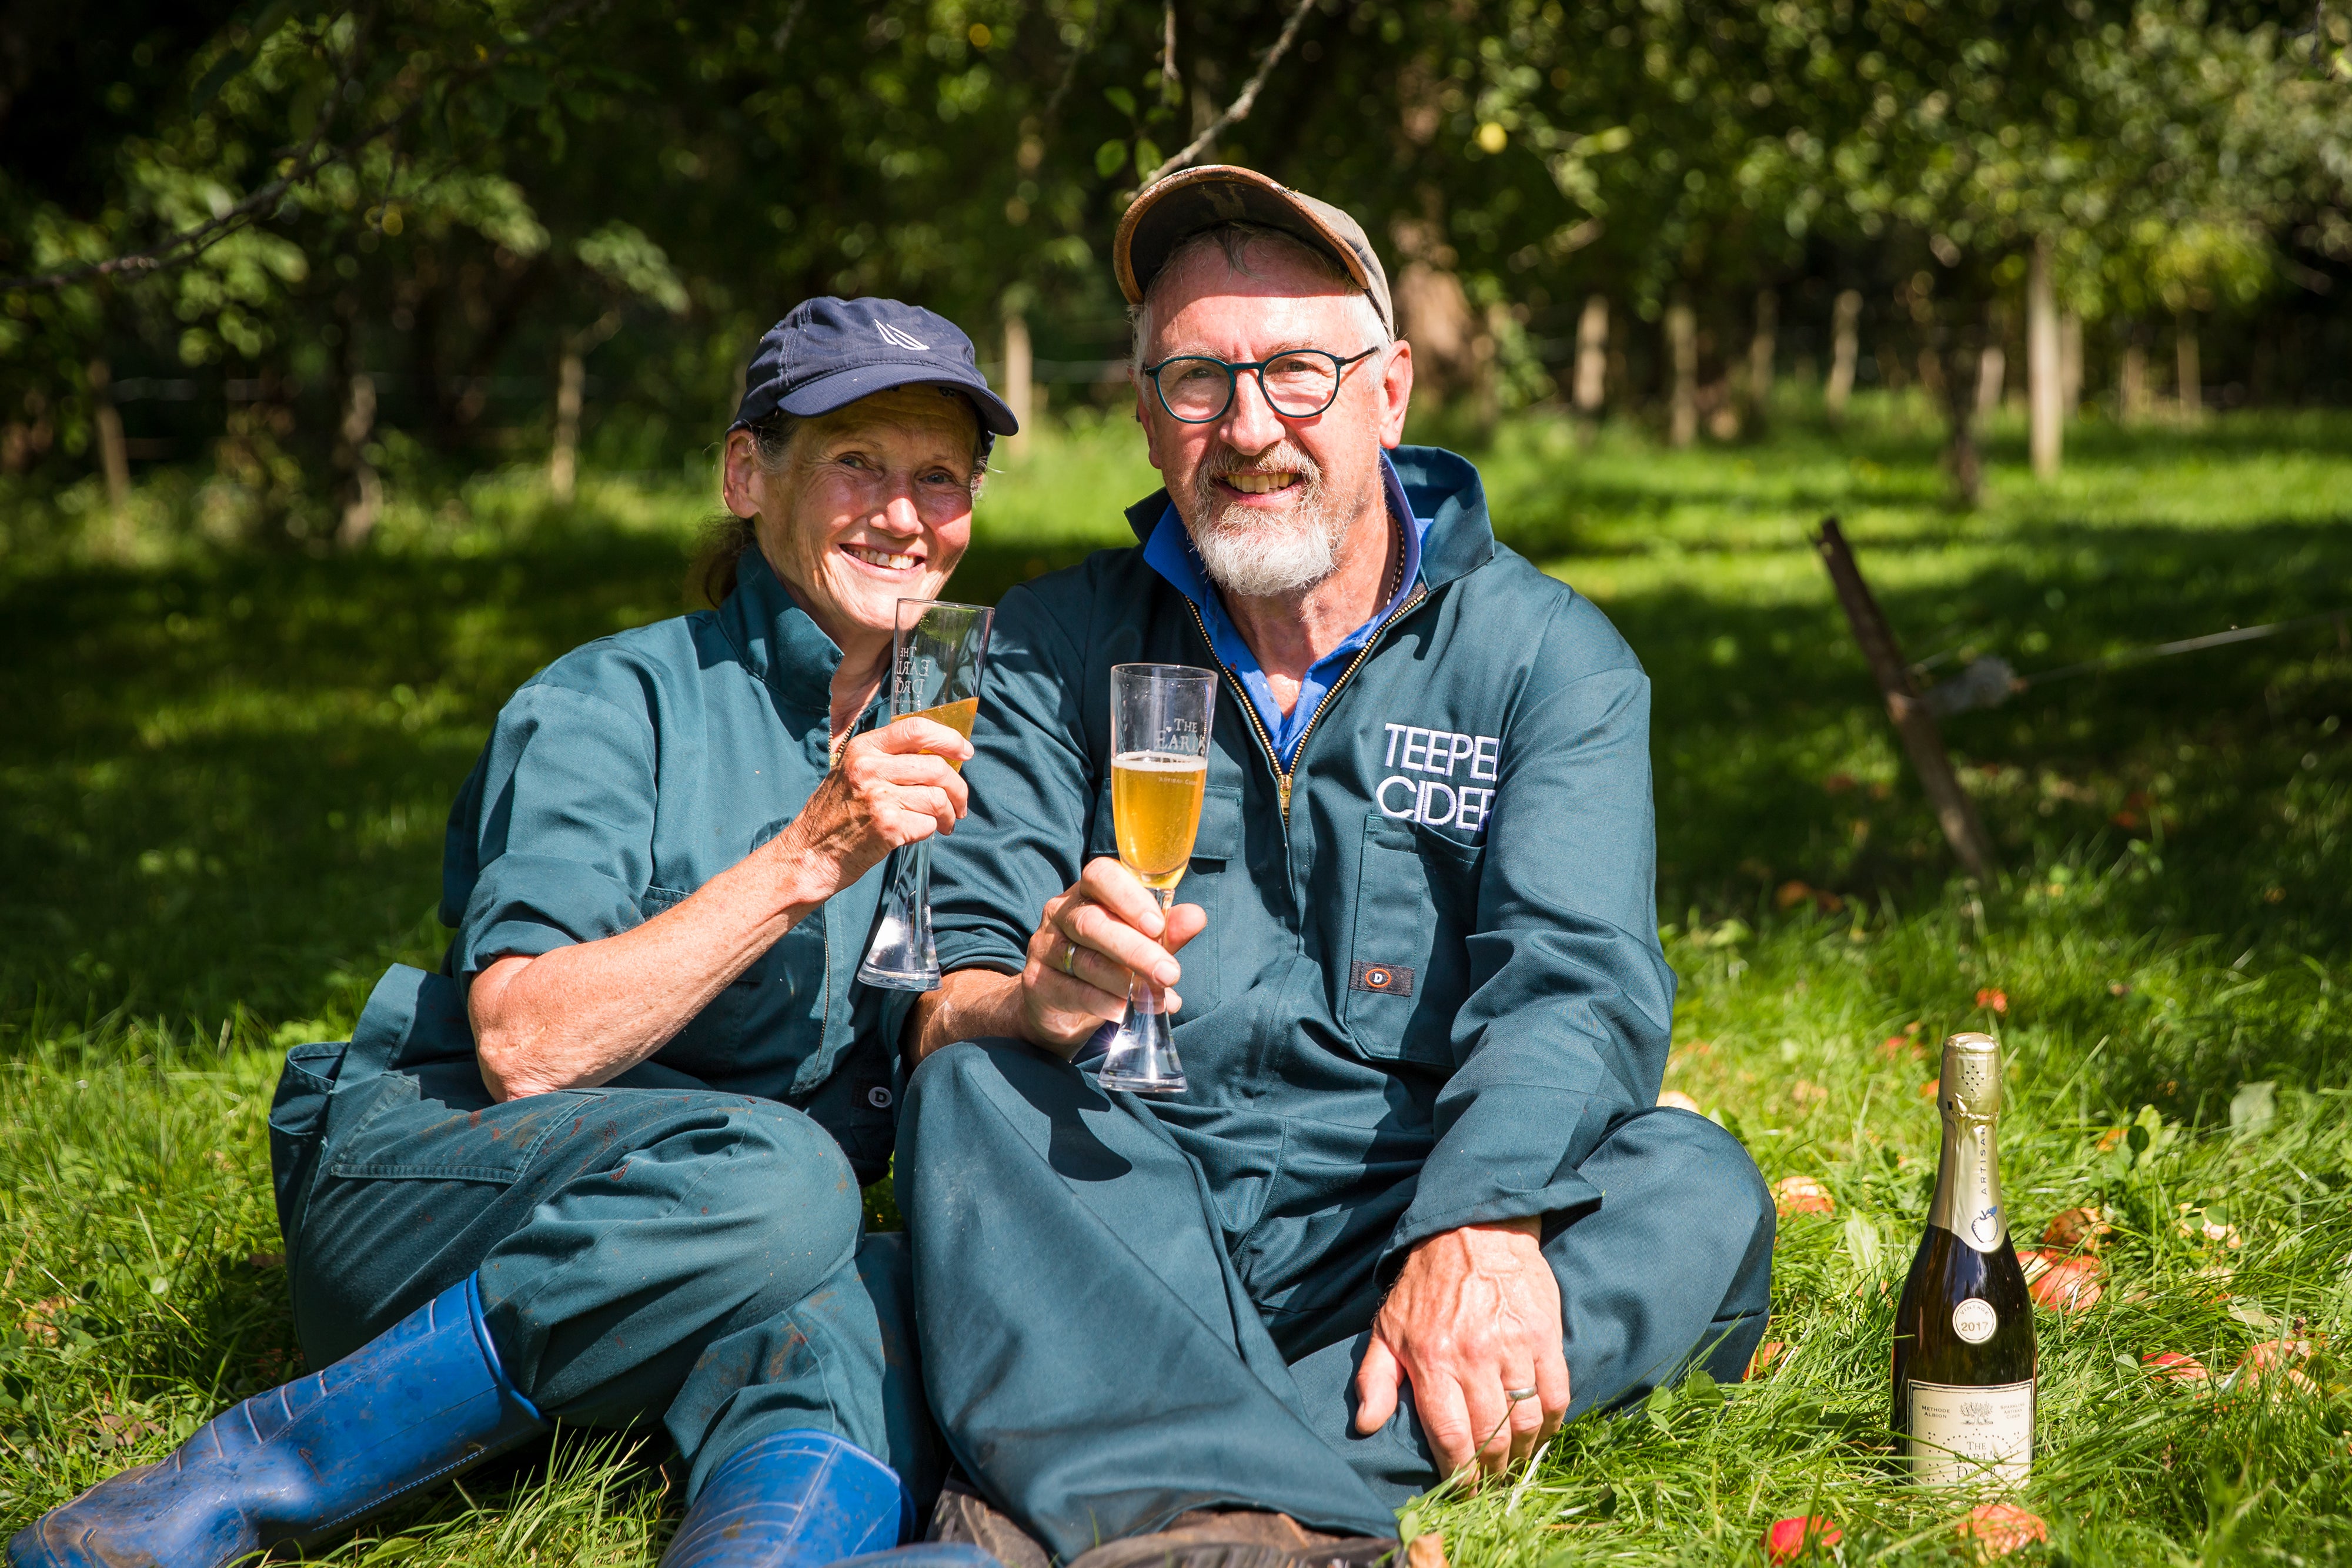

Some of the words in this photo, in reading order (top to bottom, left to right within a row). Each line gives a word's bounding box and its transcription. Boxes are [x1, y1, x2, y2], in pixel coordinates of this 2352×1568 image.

[1174, 718, 1198, 733] THE
[1385, 723, 1499, 781] TEEPE
[1374, 973, 1383, 983] D
[1960, 1305, 1989, 1316] VINTAGE
[1961, 1321, 1989, 1332] 2017
[1922, 1405, 1950, 1413] METHODE
[1966, 1441, 1986, 1450] THE
